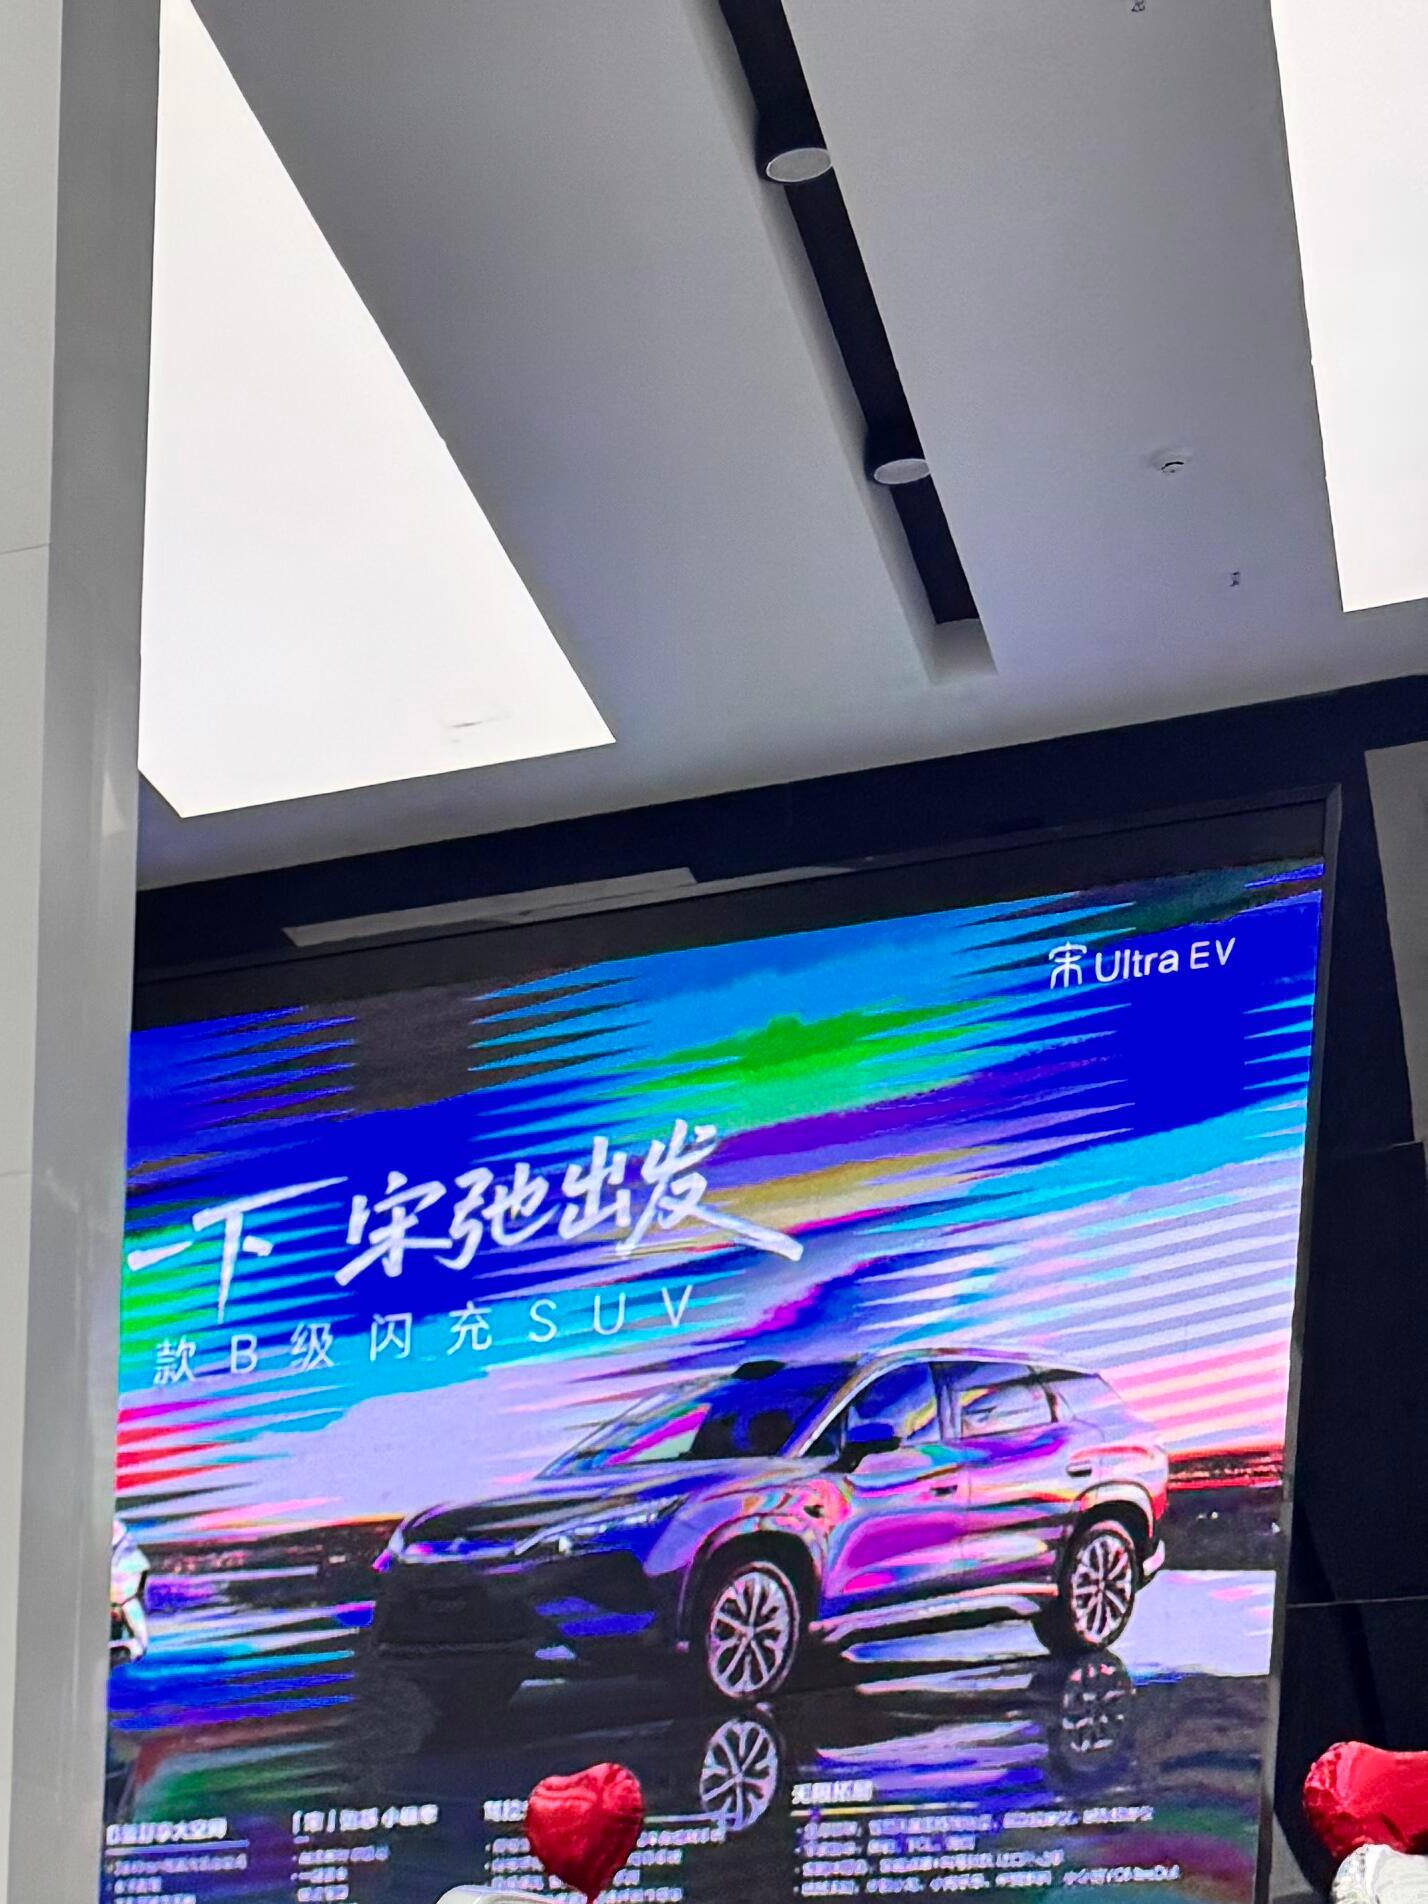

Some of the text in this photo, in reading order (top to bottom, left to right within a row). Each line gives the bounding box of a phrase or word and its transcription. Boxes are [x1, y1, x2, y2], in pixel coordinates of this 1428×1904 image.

[1095, 949, 1179, 982] Ultra
[1190, 937, 1236, 970] EV
[334, 1117, 804, 1287] 宋弛出发
